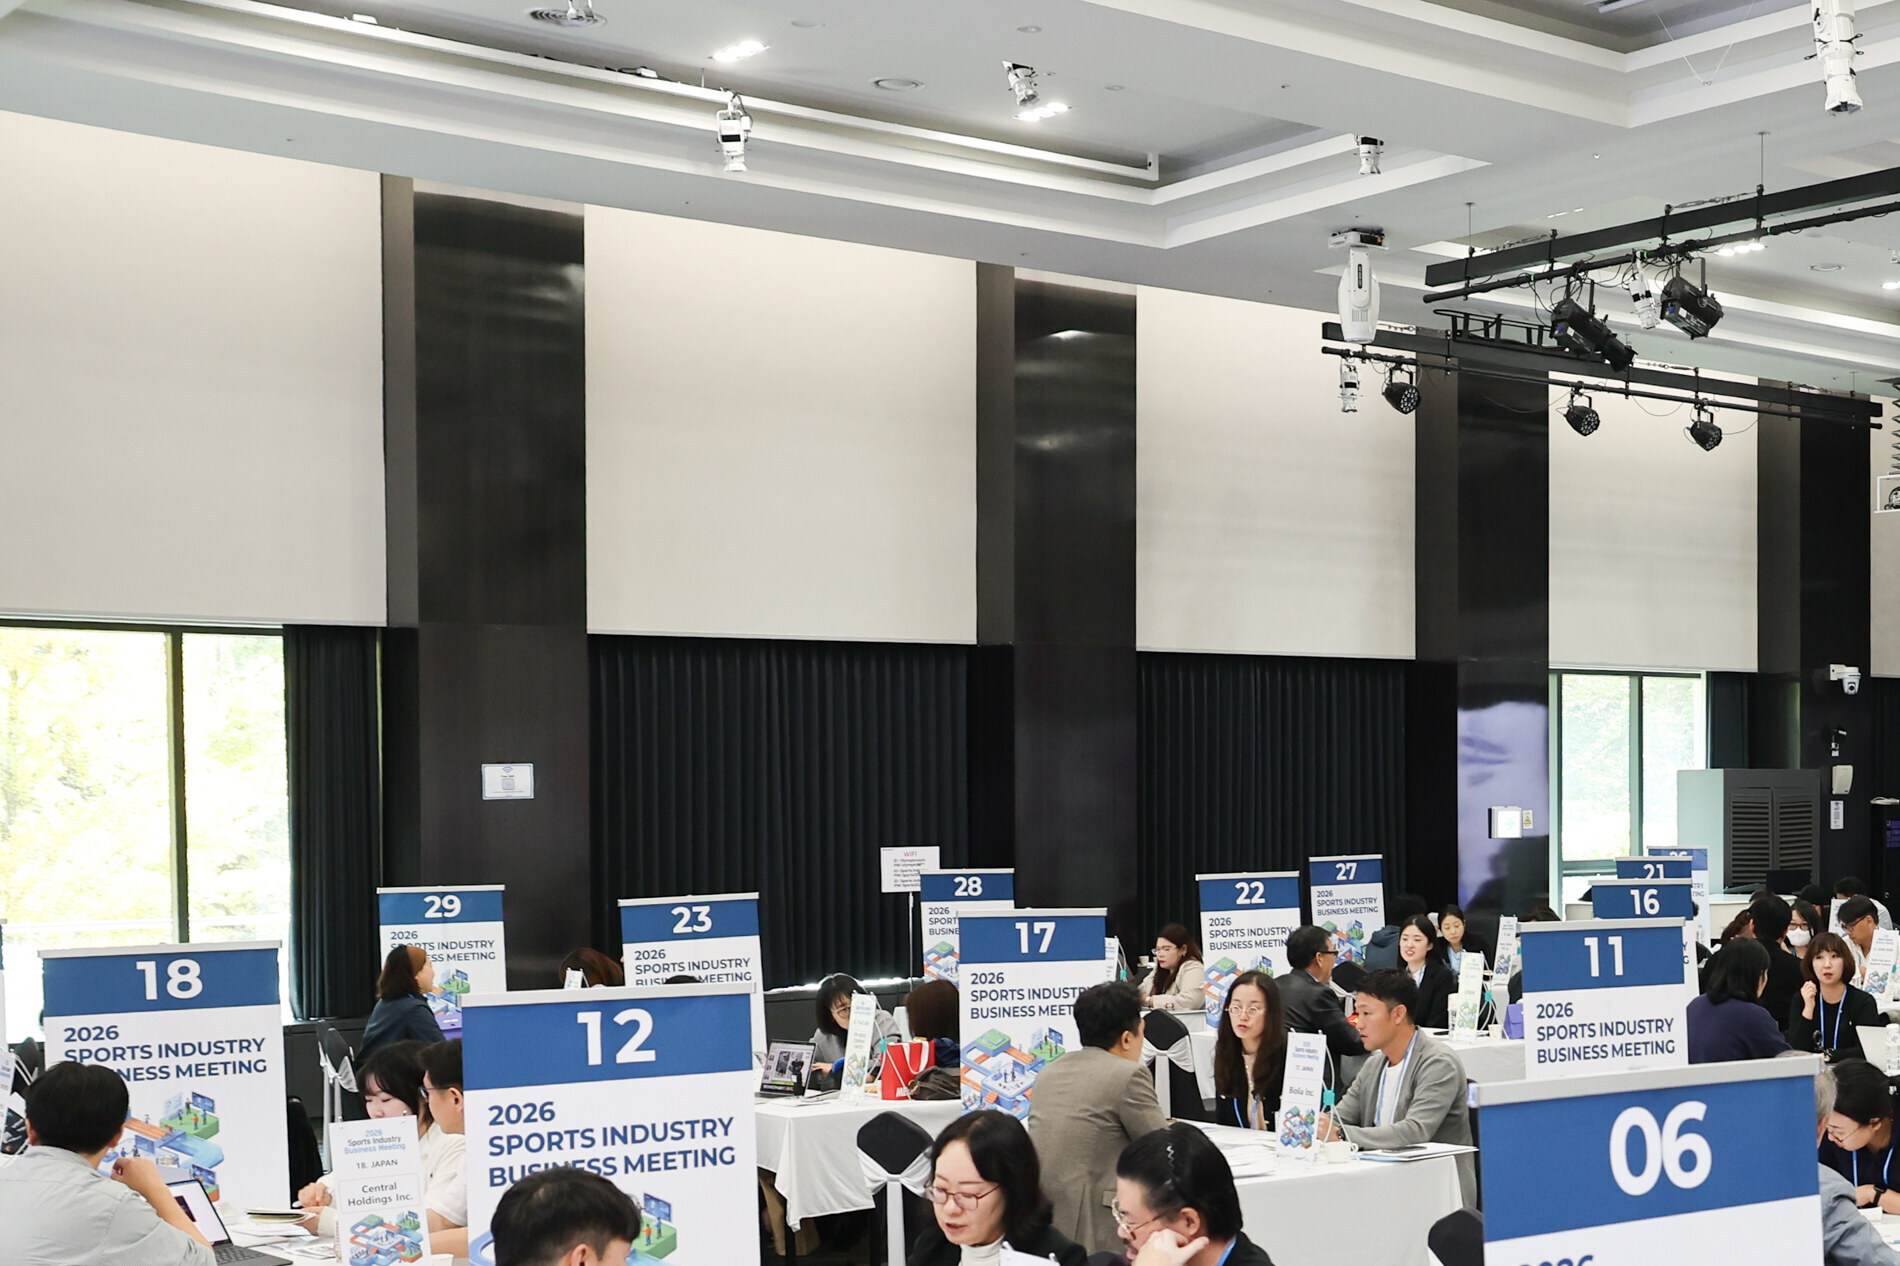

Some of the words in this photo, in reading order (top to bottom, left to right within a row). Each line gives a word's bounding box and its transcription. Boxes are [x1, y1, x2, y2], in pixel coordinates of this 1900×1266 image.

[1335, 862, 1358, 881] 27
[953, 876, 982, 896] 28
[1234, 881, 1266, 905] 22
[423, 894, 462, 918] 29
[1316, 899, 1343, 908] SPORTS
[1344, 897, 1378, 906] INDUSTRY
[1630, 888, 1660, 916] 16
[670, 905, 712, 934] 23
[1317, 908, 1348, 916] BUSINESS
[1350, 906, 1378, 915] MEETING
[1208, 918, 1232, 926] 2026
[390, 930, 418, 940] 2026
[1015, 922, 1056, 954] 17
[1209, 928, 1246, 938] SPORTS
[437, 940, 495, 950] INDUSTRY
[1210, 940, 1253, 950] BUSINESS
[446, 952, 496, 961] MEETING
[634, 949, 666, 960] 2026
[1584, 935, 1624, 978] 11
[635, 962, 686, 974] SPORTS
[688, 958, 751, 972] INDUSTRY
[136, 958, 203, 1001] 18
[699, 972, 752, 984] MEETING
[970, 972, 1005, 984] 2026
[970, 988, 1025, 1002] SPORTS
[970, 1006, 1036, 1020] BUSINESS
[1536, 1002, 1574, 1020] 2026
[64, 1025, 120, 1042] 2026
[576, 1008, 657, 1066] 12
[1536, 1022, 1596, 1042] SPORTS
[1600, 1018, 1674, 1040] INDUSTRY
[64, 1044, 153, 1064] SPORTS
[158, 1037, 266, 1059] INDUSTRY
[1537, 1044, 1609, 1064] BUSINESS
[1612, 1040, 1676, 1060] MEETING
[176, 1059, 268, 1079] MEETING
[488, 1102, 556, 1126] 2026
[347, 1138, 370, 1147] Sports
[372, 1136, 401, 1144] Industry
[488, 1128, 596, 1158] SPORTS
[602, 1116, 734, 1147] INDUSTRY
[344, 1146, 376, 1154] Business
[378, 1143, 406, 1152] Meeting
[1608, 1100, 1712, 1197] 06
[371, 1160, 398, 1168] JAPAN
[624, 1146, 736, 1175] MEETING
[362, 1183, 397, 1194] Central
[348, 1195, 392, 1208] Holdings
[396, 1192, 414, 1201] Inc.
